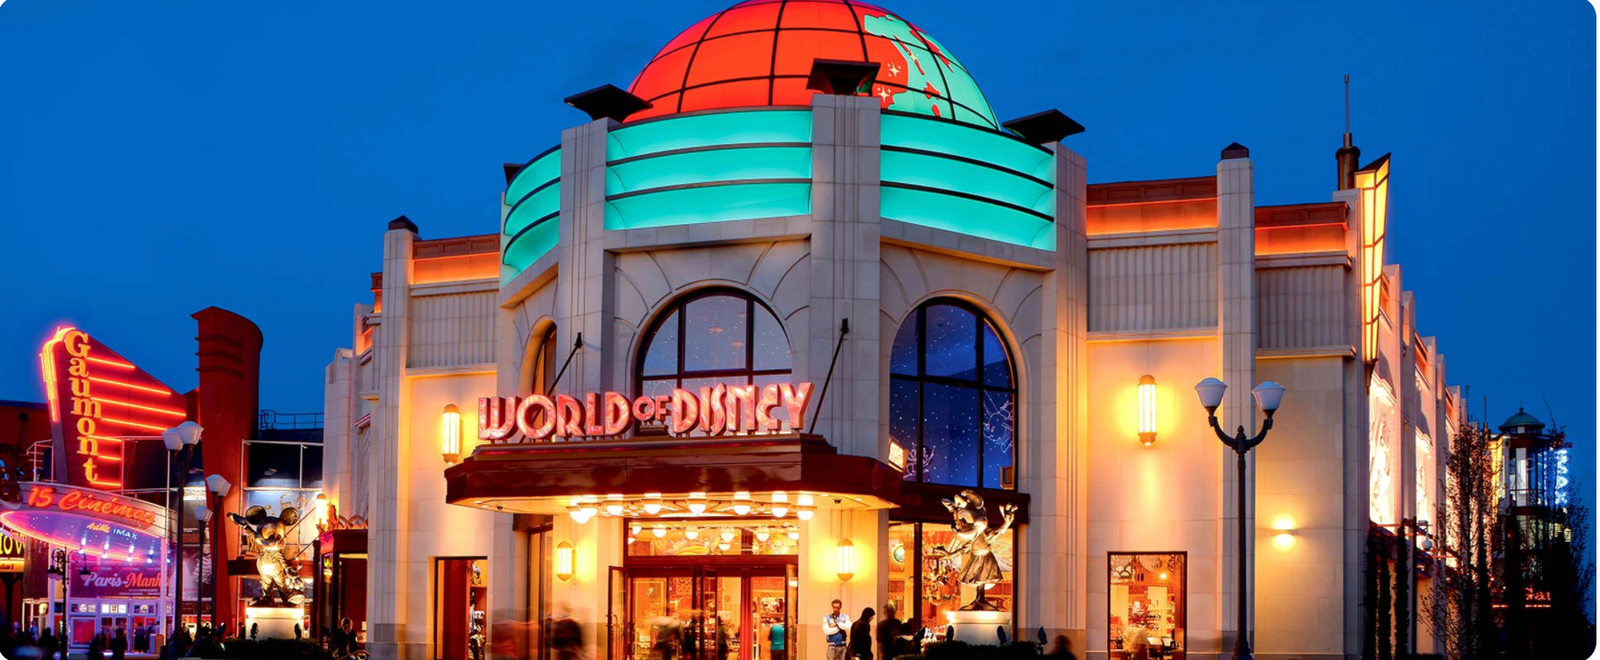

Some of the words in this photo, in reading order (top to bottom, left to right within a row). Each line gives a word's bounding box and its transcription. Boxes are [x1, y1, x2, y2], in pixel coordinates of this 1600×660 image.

[65, 330, 102, 483] Gaumont
[478, 392, 632, 440] WORLD
[632, 395, 672, 423] OF
[672, 382, 815, 437] DISNEY
[28, 485, 54, 508] 15
[58, 490, 156, 525] Cinémas
[113, 528, 138, 540] IMAX
[83, 571, 163, 589] Paris-Manh
